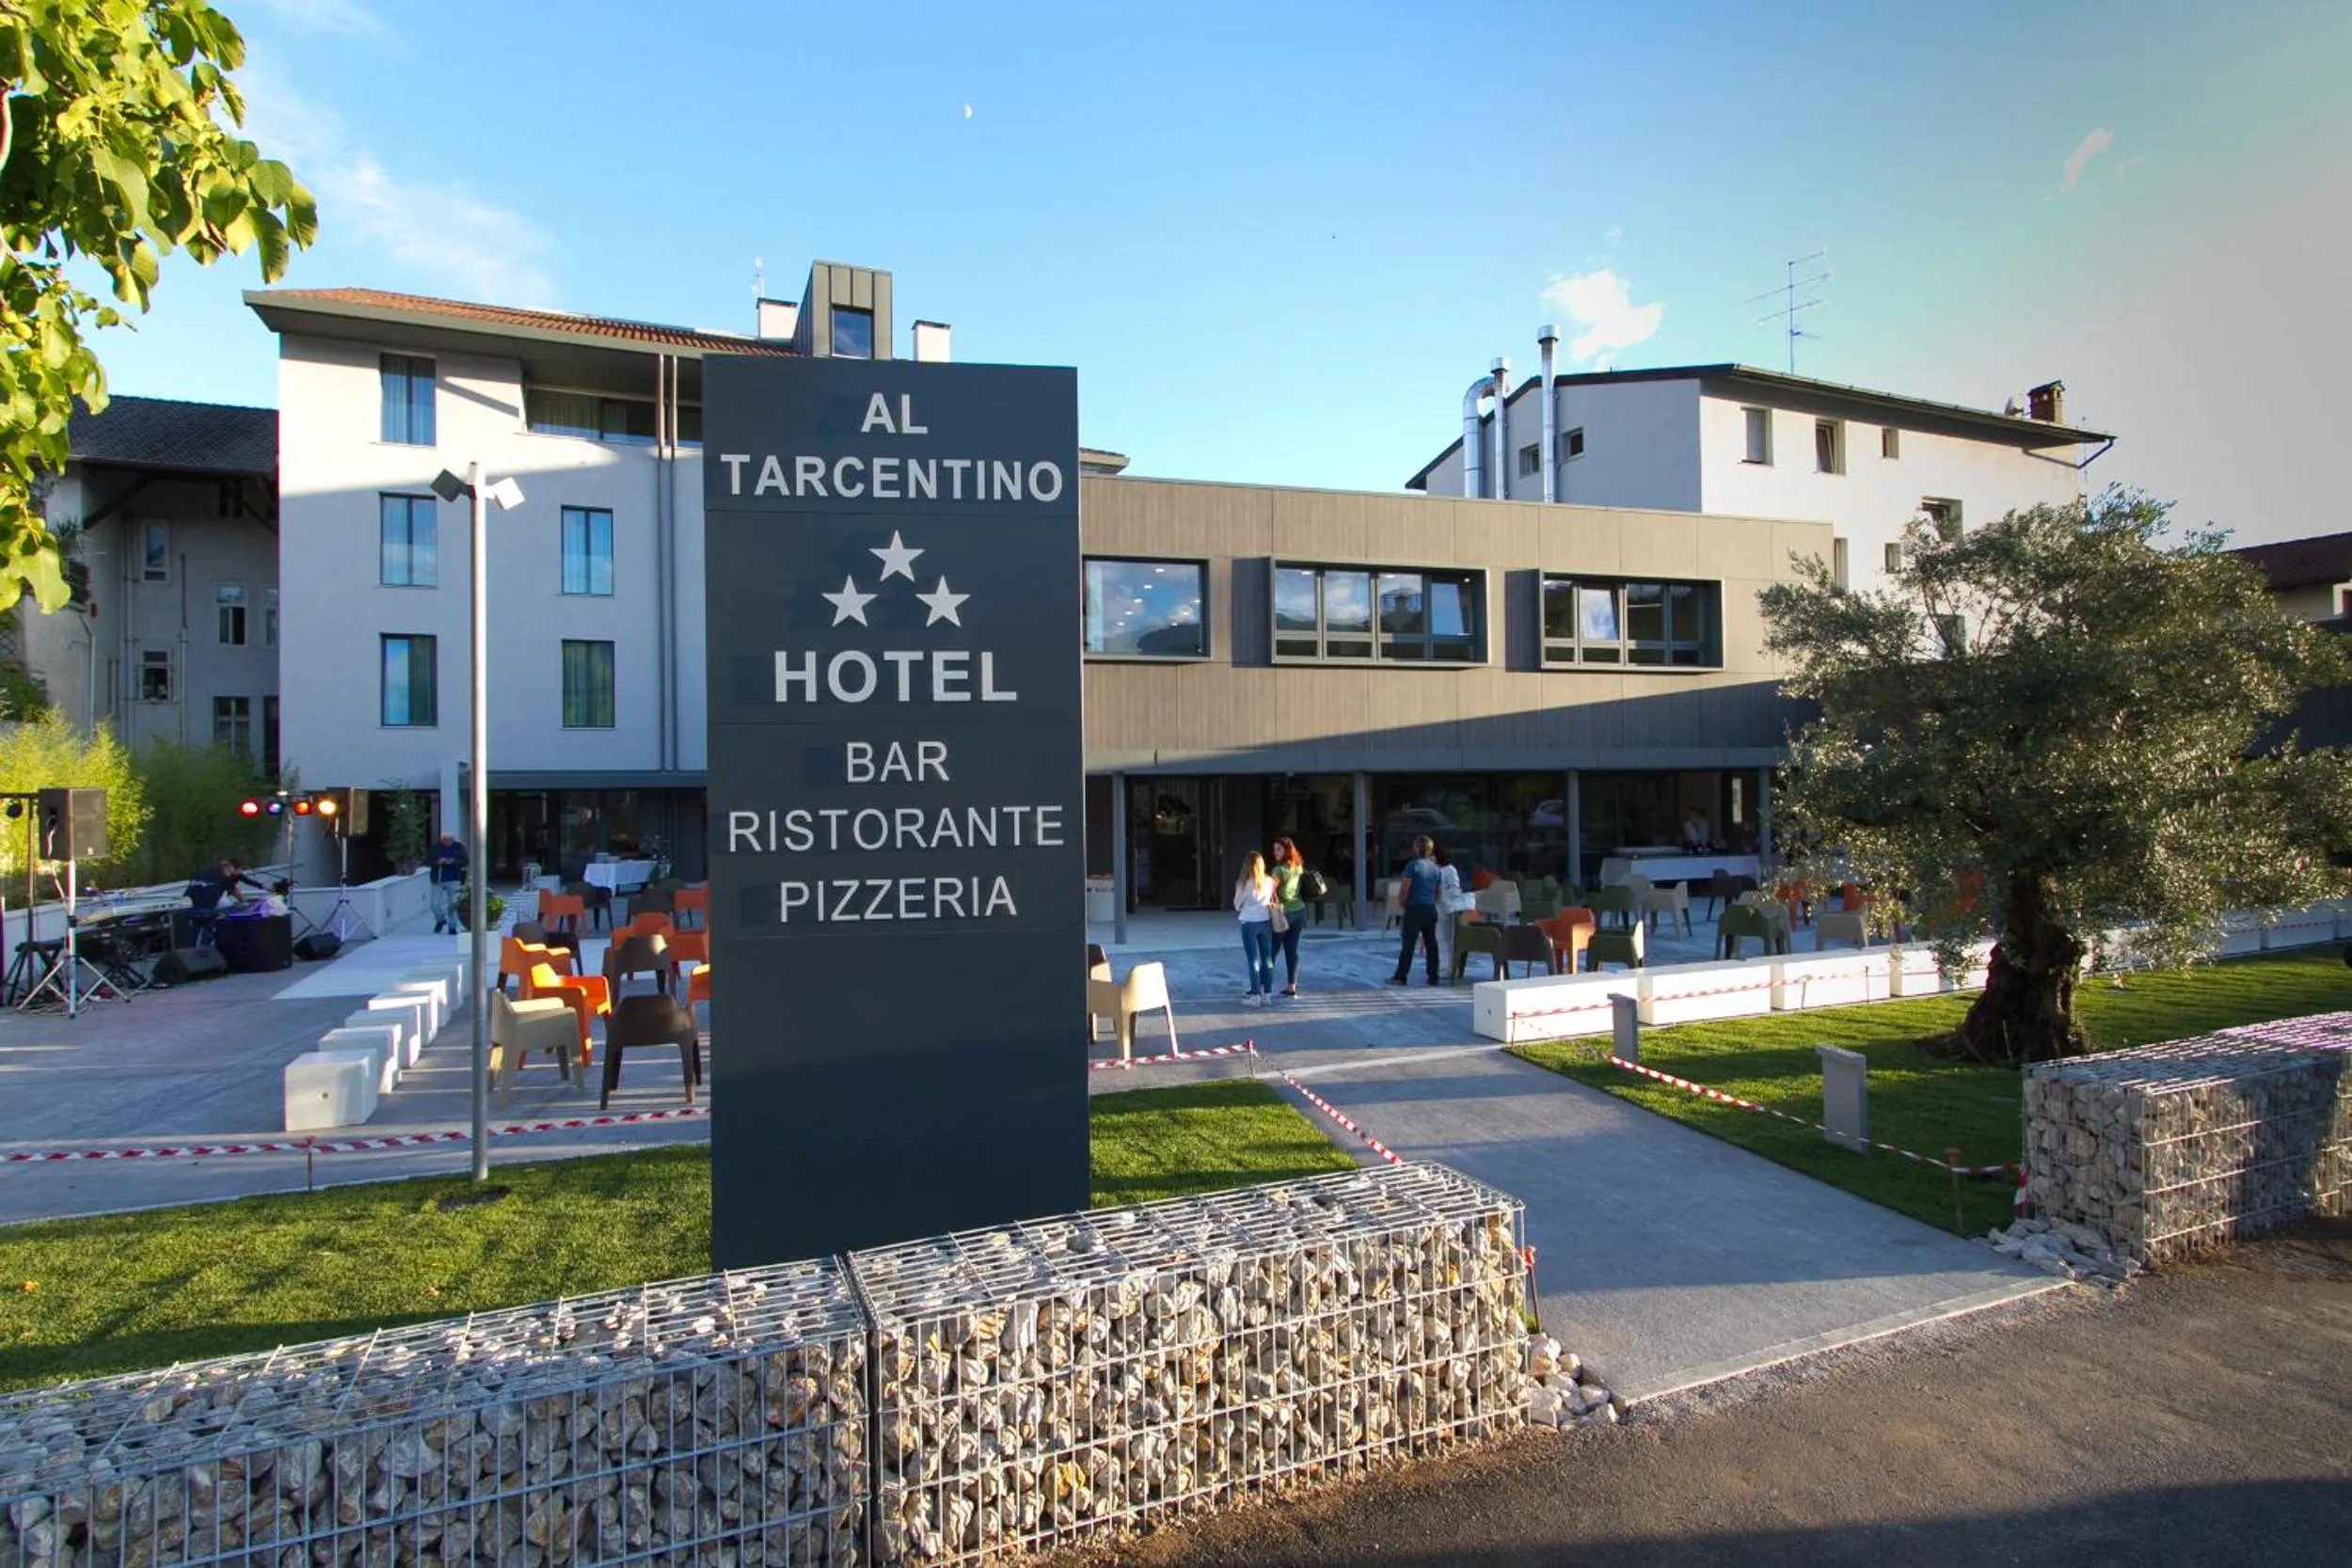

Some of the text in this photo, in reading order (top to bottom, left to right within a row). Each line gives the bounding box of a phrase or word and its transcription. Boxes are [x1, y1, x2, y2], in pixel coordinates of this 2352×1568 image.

[861, 392, 929, 435] AL
[720, 453, 1063, 502] TARCENTINO
[774, 650, 1018, 703] HOTEL
[847, 740, 950, 783] BAR
[728, 805, 1065, 852] RISTORANTE
[780, 876, 1018, 923] PIZZERIA
